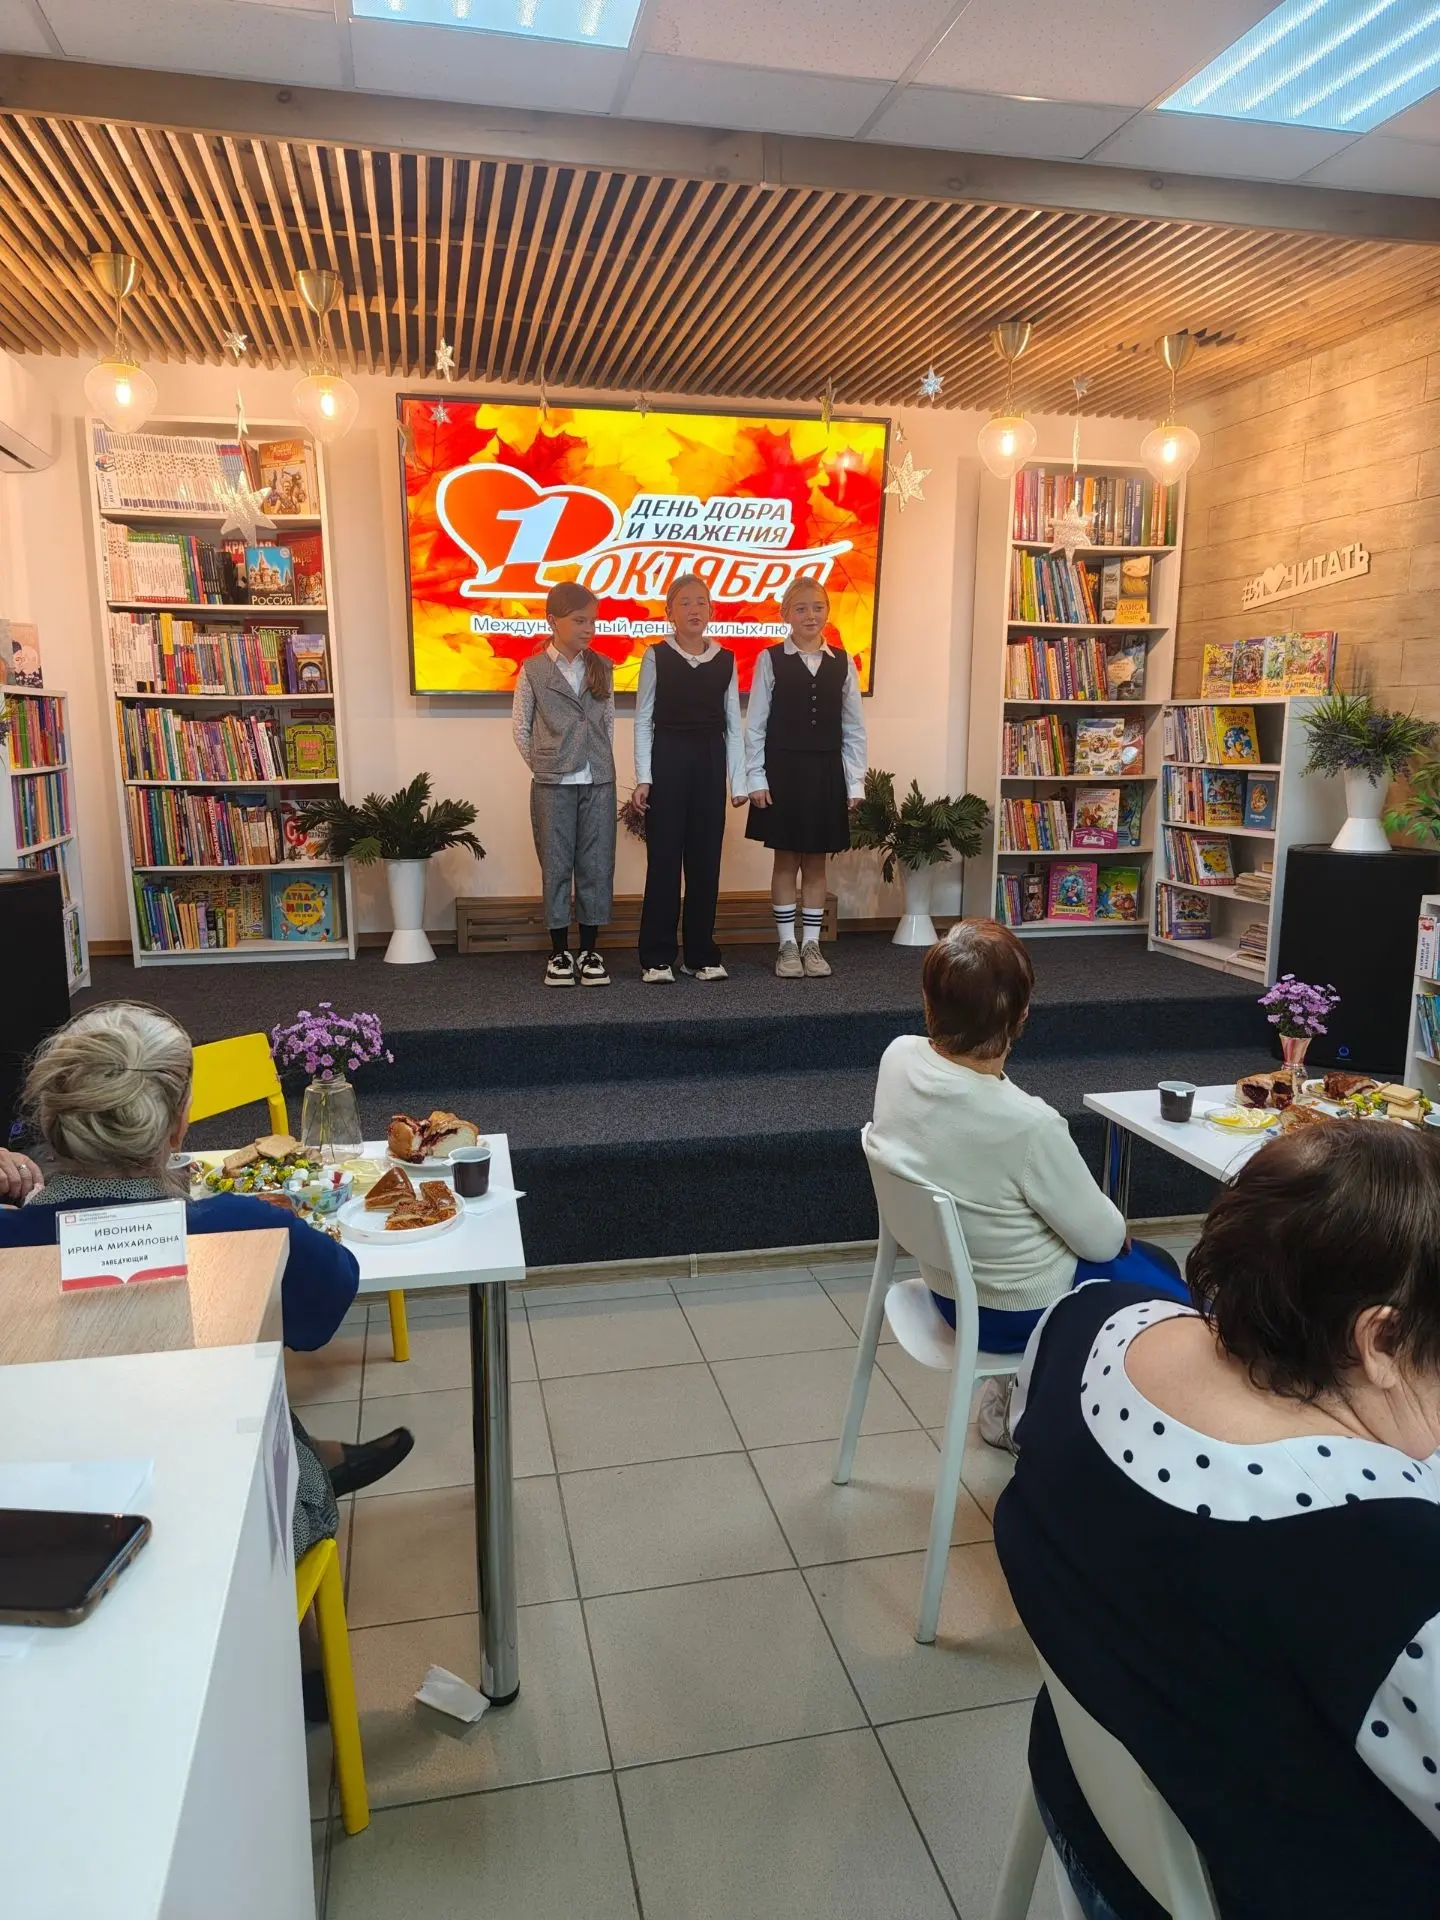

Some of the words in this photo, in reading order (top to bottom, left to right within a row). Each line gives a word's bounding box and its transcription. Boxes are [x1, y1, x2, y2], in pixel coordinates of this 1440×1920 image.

[631, 499, 699, 519] ДЕНЬ
[704, 502, 785, 521] ДОБРА
[626, 523, 645, 539] И
[651, 523, 788, 543] УВАЖЕНИЯ
[467, 496, 569, 593] 1
[251, 595, 293, 605] РОССИЯ
[633, 623, 675, 635] день
[286, 903, 320, 912] МИРА
[94, 1223, 153, 1237] ИВОНИНА
[67, 1244, 104, 1255] ИРИНА
[107, 1235, 180, 1250] МИХАЙЛОВНА
[101, 1254, 149, 1266] ЗАВЕДУЮЩИЙ
